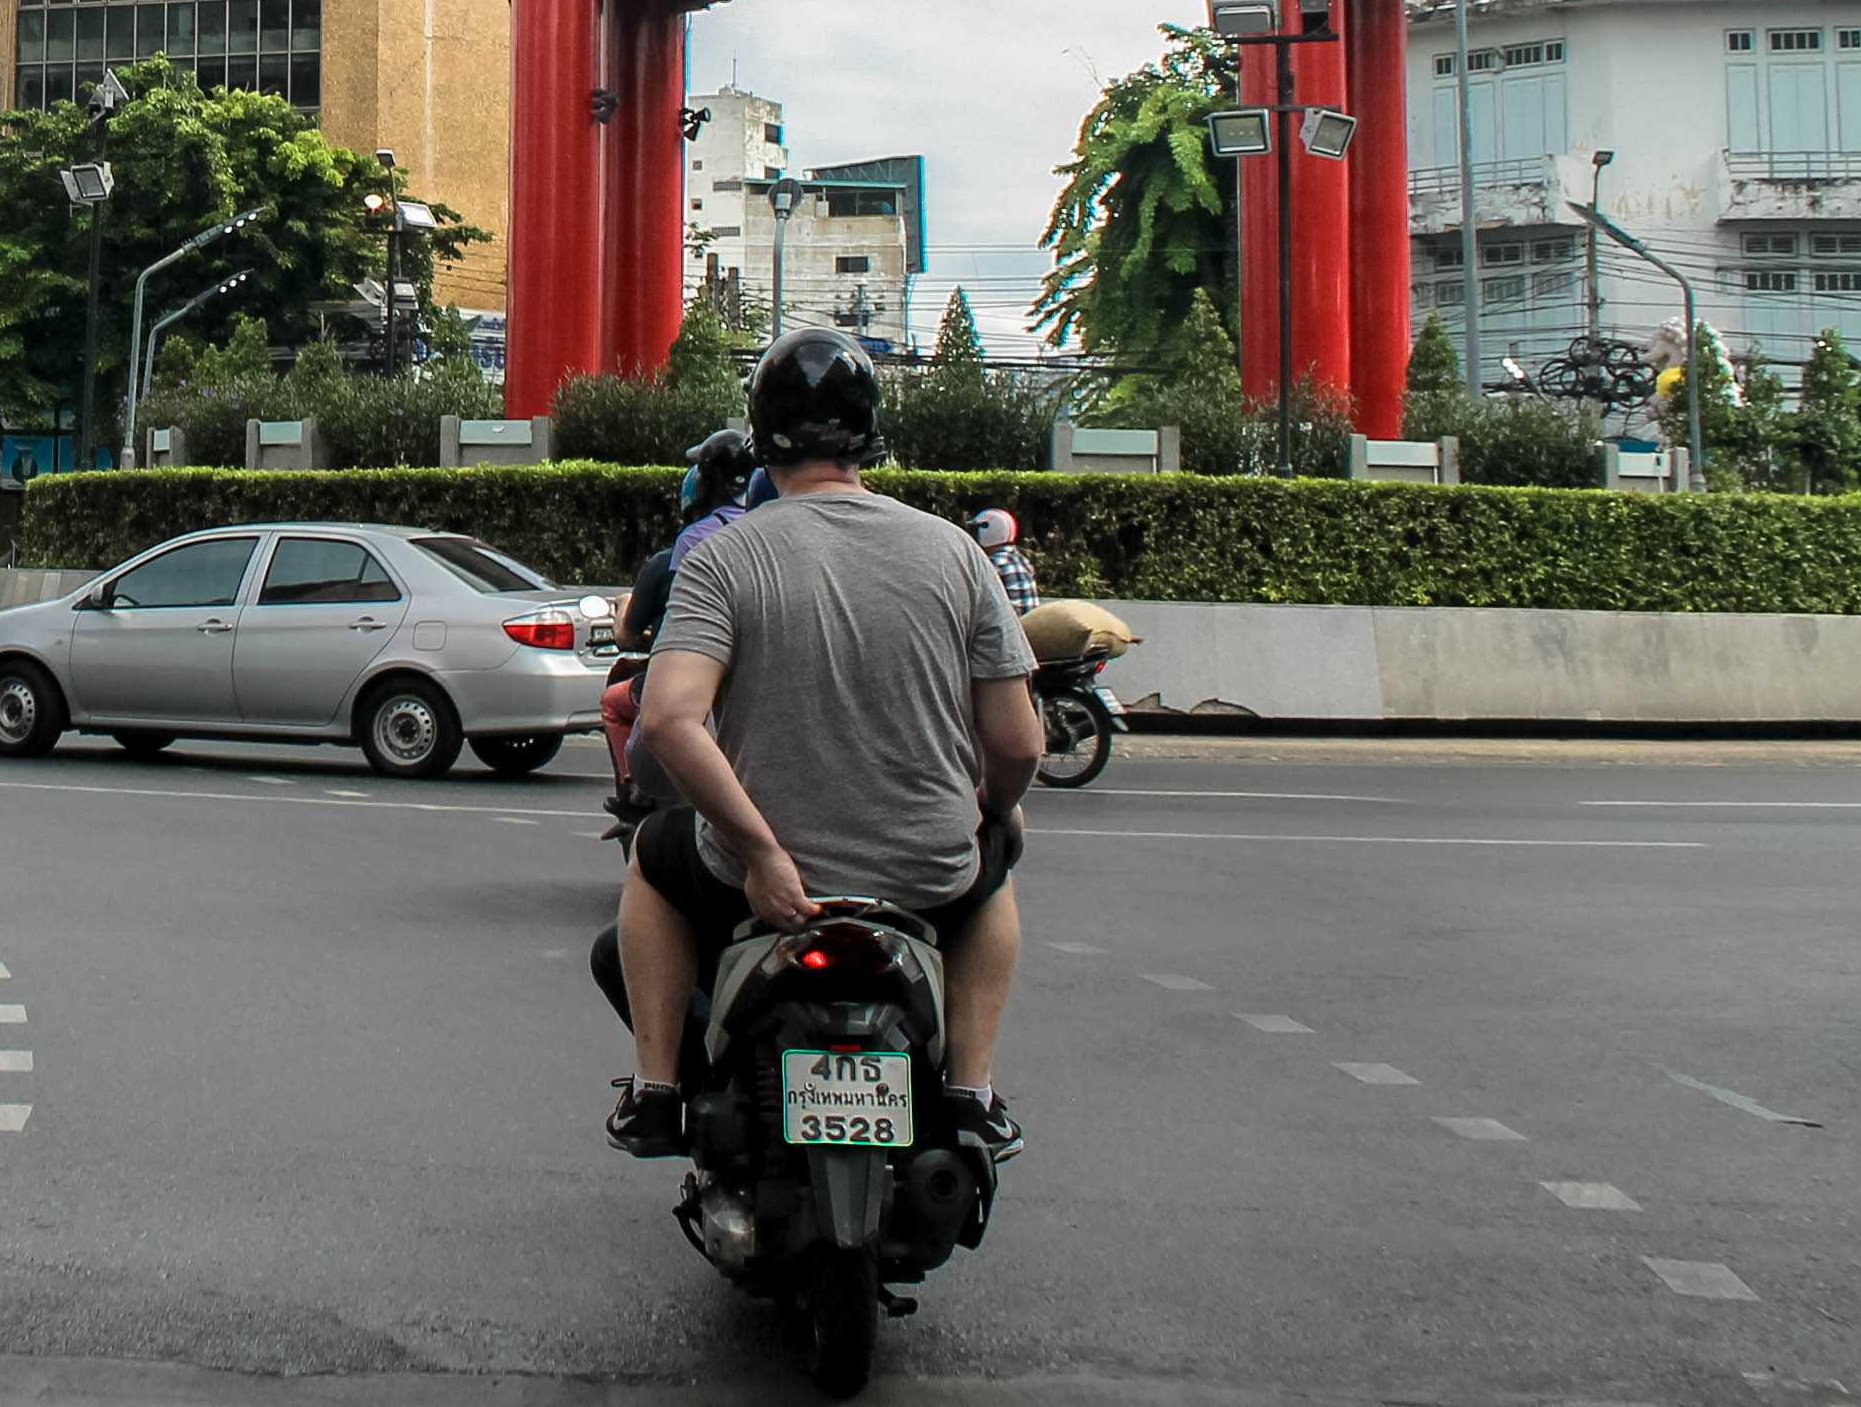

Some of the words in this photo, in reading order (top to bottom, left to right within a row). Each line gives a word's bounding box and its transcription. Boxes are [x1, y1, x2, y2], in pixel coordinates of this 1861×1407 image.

[811, 1054, 882, 1082] 4กธ
[788, 1089, 909, 1110] กรุงเทพมหานคร
[801, 1114, 895, 1143] 3528
